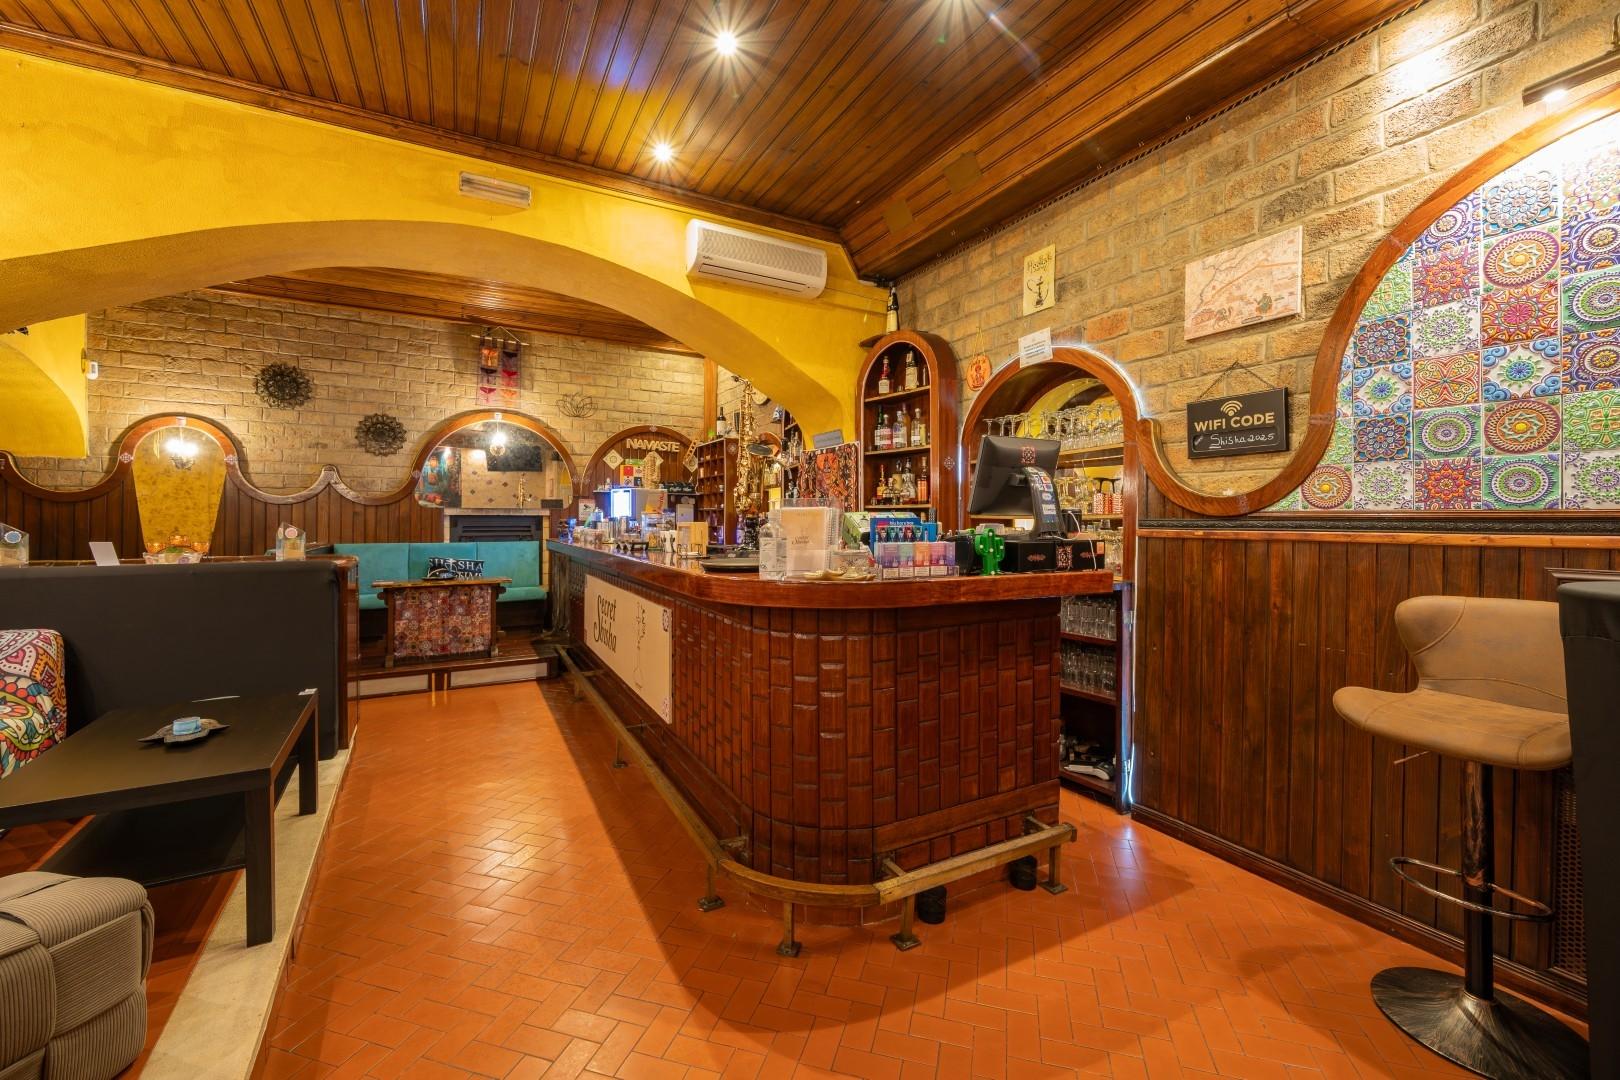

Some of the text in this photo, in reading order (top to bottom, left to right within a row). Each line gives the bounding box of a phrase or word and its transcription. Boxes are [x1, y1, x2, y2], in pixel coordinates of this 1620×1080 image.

[1194, 412, 1275, 432] WIFI CODE
[626, 438, 680, 452] NAMASTE
[597, 594, 617, 622] Secret
[593, 615, 617, 653] Shisha
